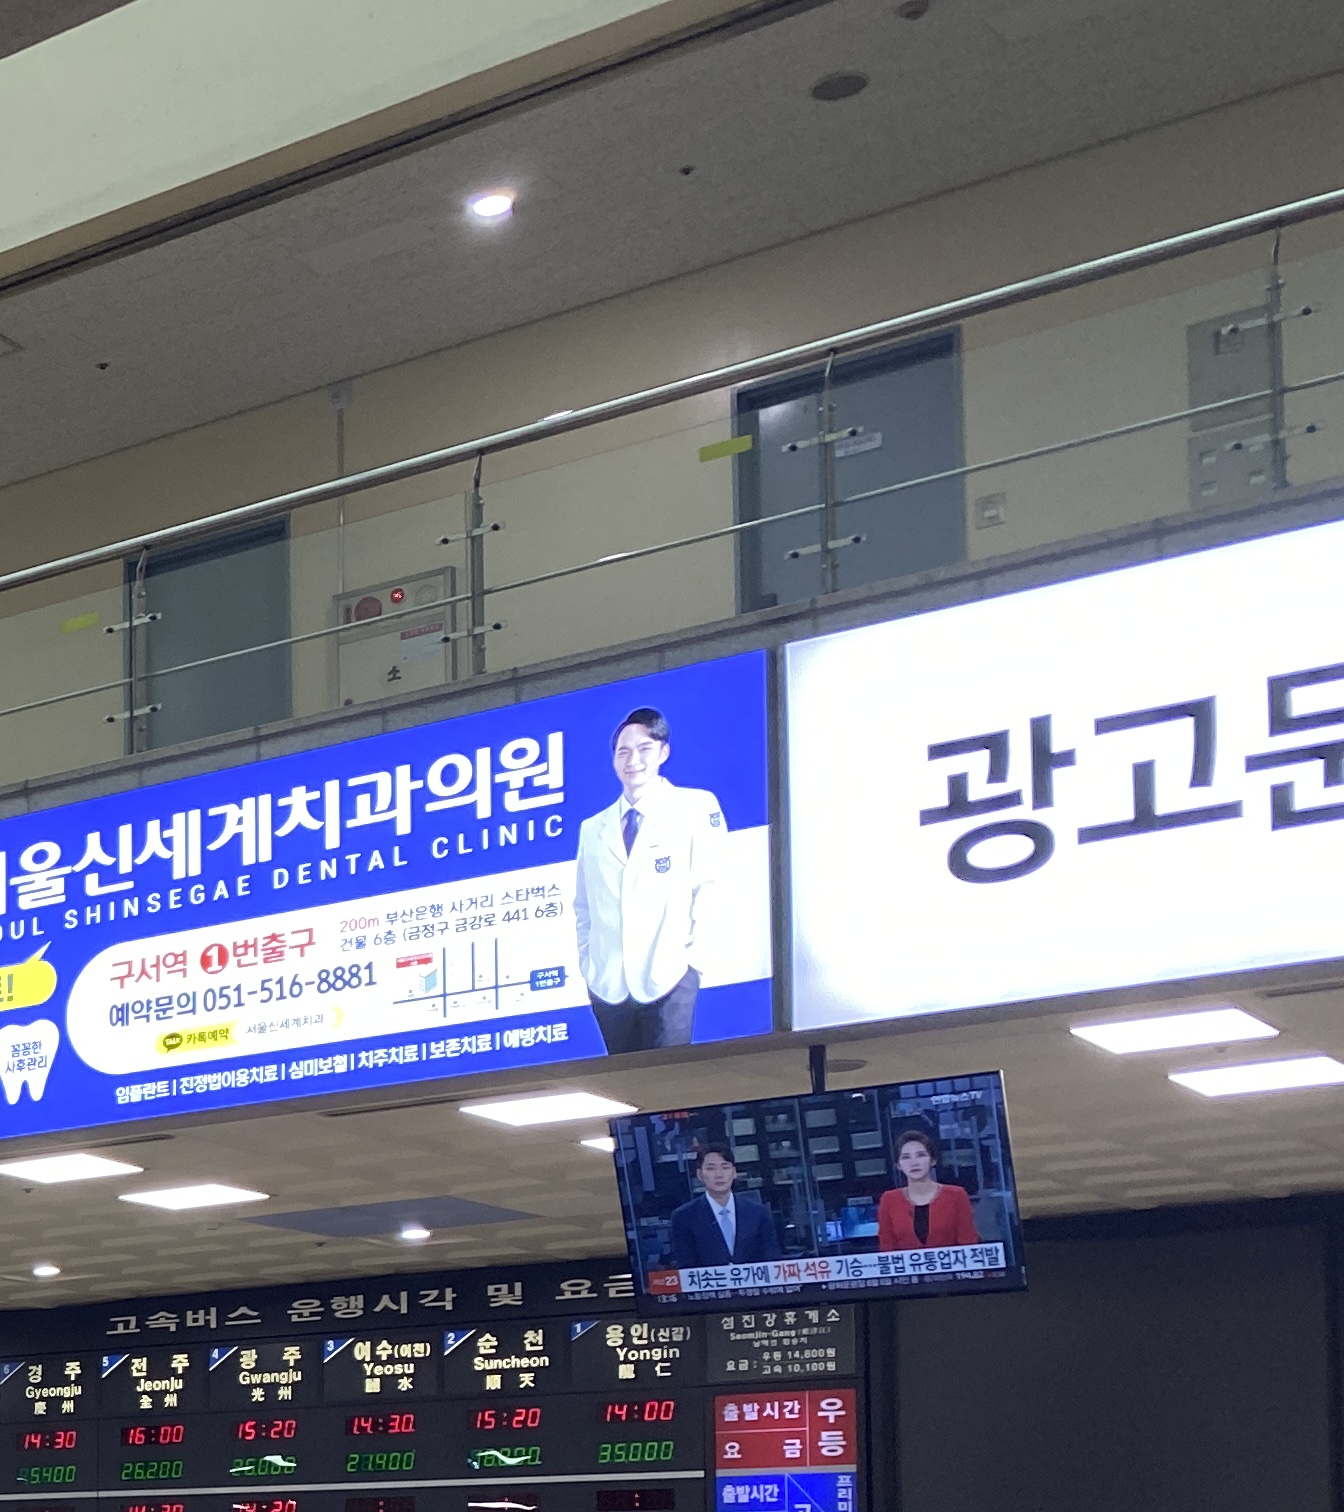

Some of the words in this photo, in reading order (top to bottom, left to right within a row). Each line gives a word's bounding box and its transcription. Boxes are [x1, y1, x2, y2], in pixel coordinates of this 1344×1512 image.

[64, 875, 251, 929] SHINSEGAE
[272, 845, 407, 889] DENTAL
[432, 814, 565, 860] CLINIC
[339, 915, 381, 934] 200m
[384, 901, 444, 928] 부산은행
[449, 895, 494, 915] 사거리
[500, 883, 562, 907] 스타벅스
[339, 933, 368, 953] 건물
[373, 928, 397, 946] 6층
[402, 921, 451, 943] (금정구
[454, 912, 497, 935] 금강로
[501, 907, 531, 925] 441
[534, 901, 565, 921] 6층)
[109, 949, 189, 990] 구서역
[231, 928, 317, 970] 번출구
[108, 989, 198, 1028] 예약문의
[203, 961, 377, 1013] 051-516-8881
[186, 1028, 231, 1046] 카톡예약
[245, 1012, 325, 1035] 서울신세계치과
[11, 1040, 42, 1058] 꼼꼼한
[5, 1055, 47, 1074] 사후관리
[115, 1082, 169, 1105] 임플란트
[179, 1065, 279, 1097] 진정법이용치료
[289, 1056, 348, 1079] 심미보철
[358, 1047, 419, 1070] 치주치료
[429, 1035, 493, 1062] 보존치료
[503, 1024, 569, 1050] 예방치료
[687, 1268, 727, 1290] 치솟는
[729, 1265, 770, 1285] 유가에
[773, 1263, 801, 1282] 가짜
[803, 1260, 831, 1280] 석유
[909, 1250, 967, 1272] 유통업자
[970, 1245, 1000, 1268] 적발
[106, 1304, 262, 1336] 고속버스
[287, 1288, 457, 1322] 운행시각
[486, 1282, 523, 1307] 및
[473, 1355, 550, 1371] Suncheon
[616, 1346, 680, 1362] Yongin
[238, 1369, 302, 1385] Gwangju
[363, 1362, 415, 1376] Yeosu
[25, 1384, 82, 1399] Gyeongju
[136, 1376, 183, 1392] Jeonju
[476, 1408, 541, 1429] 15:20
[605, 1400, 676, 1422] 14:00
[723, 1400, 801, 1422] 출발시간
[24, 1431, 77, 1449] 14:30
[128, 1425, 185, 1445] 16:00
[238, 1420, 297, 1440] 15:20
[723, 1484, 779, 1503] 출발시간
